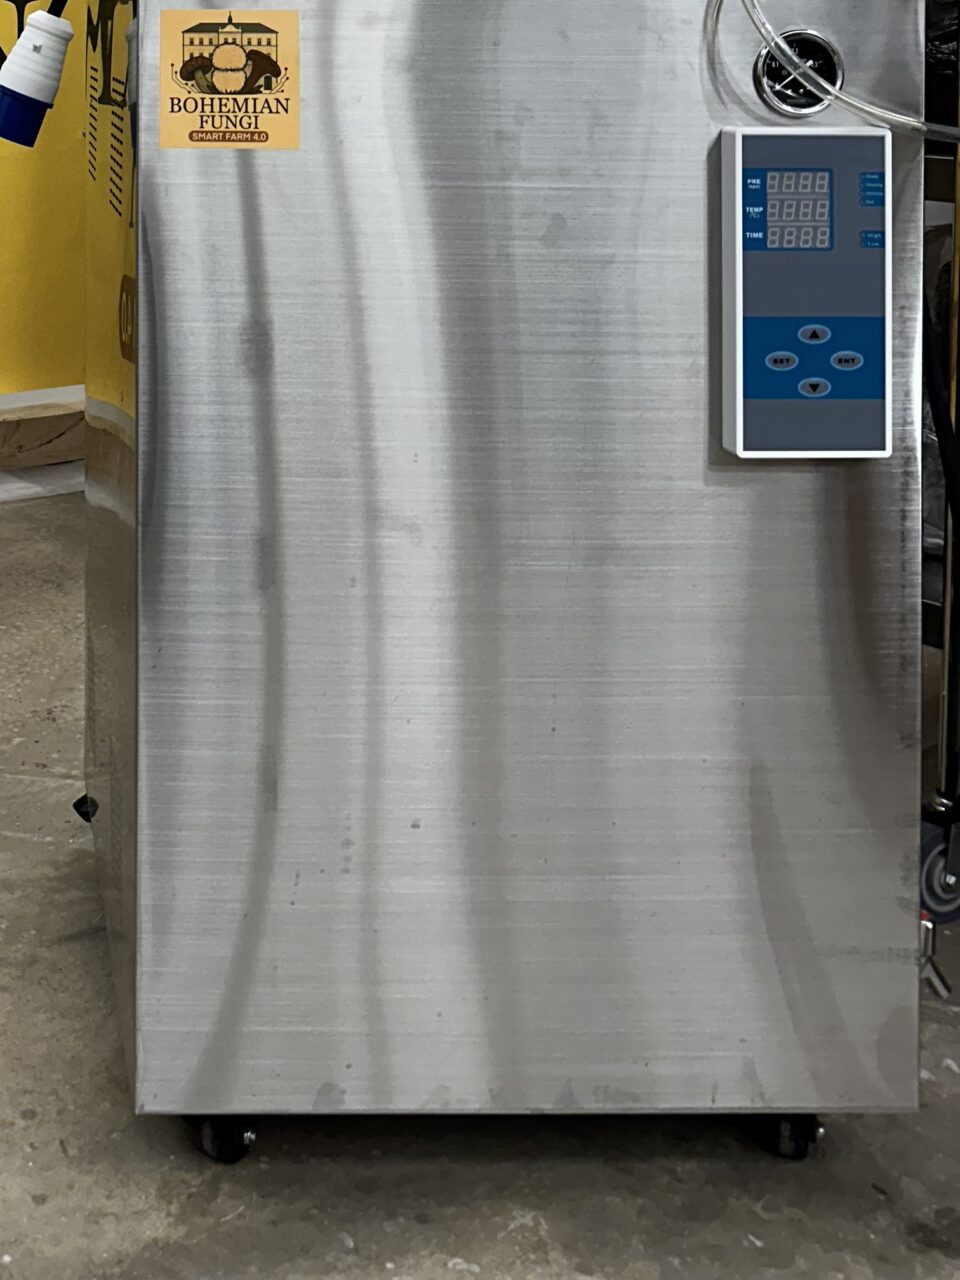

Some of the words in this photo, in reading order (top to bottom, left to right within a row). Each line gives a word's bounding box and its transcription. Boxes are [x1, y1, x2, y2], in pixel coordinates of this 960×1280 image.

[169, 96, 291, 115] BOHEMIAN
[198, 114, 260, 130] FUNGI
[192, 132, 224, 140] SMART
[225, 132, 251, 141] FARM
[252, 133, 267, 141] 4.0
